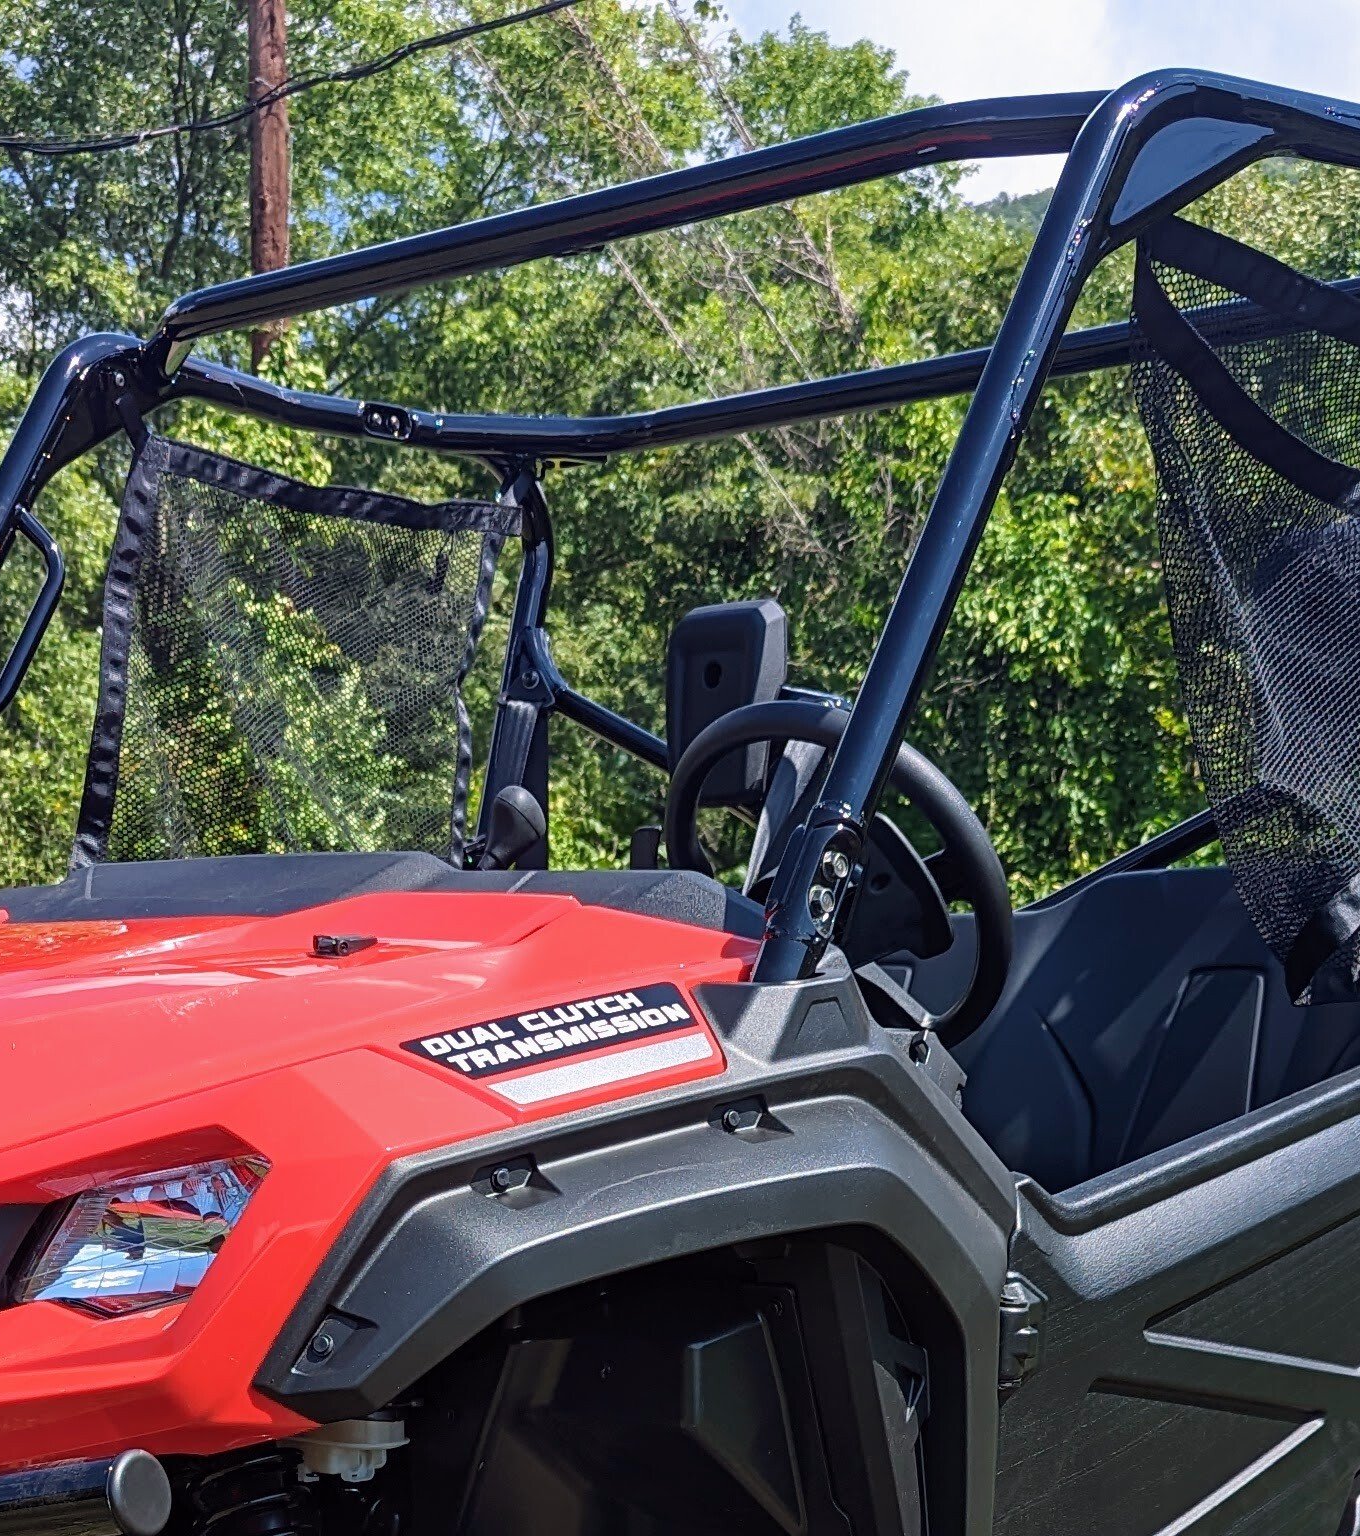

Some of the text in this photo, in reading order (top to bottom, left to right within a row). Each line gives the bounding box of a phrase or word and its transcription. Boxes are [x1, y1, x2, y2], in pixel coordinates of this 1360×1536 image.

[420, 992, 645, 1057] DUAL CLUTCH
[446, 1002, 691, 1073] TRANSMISSION
